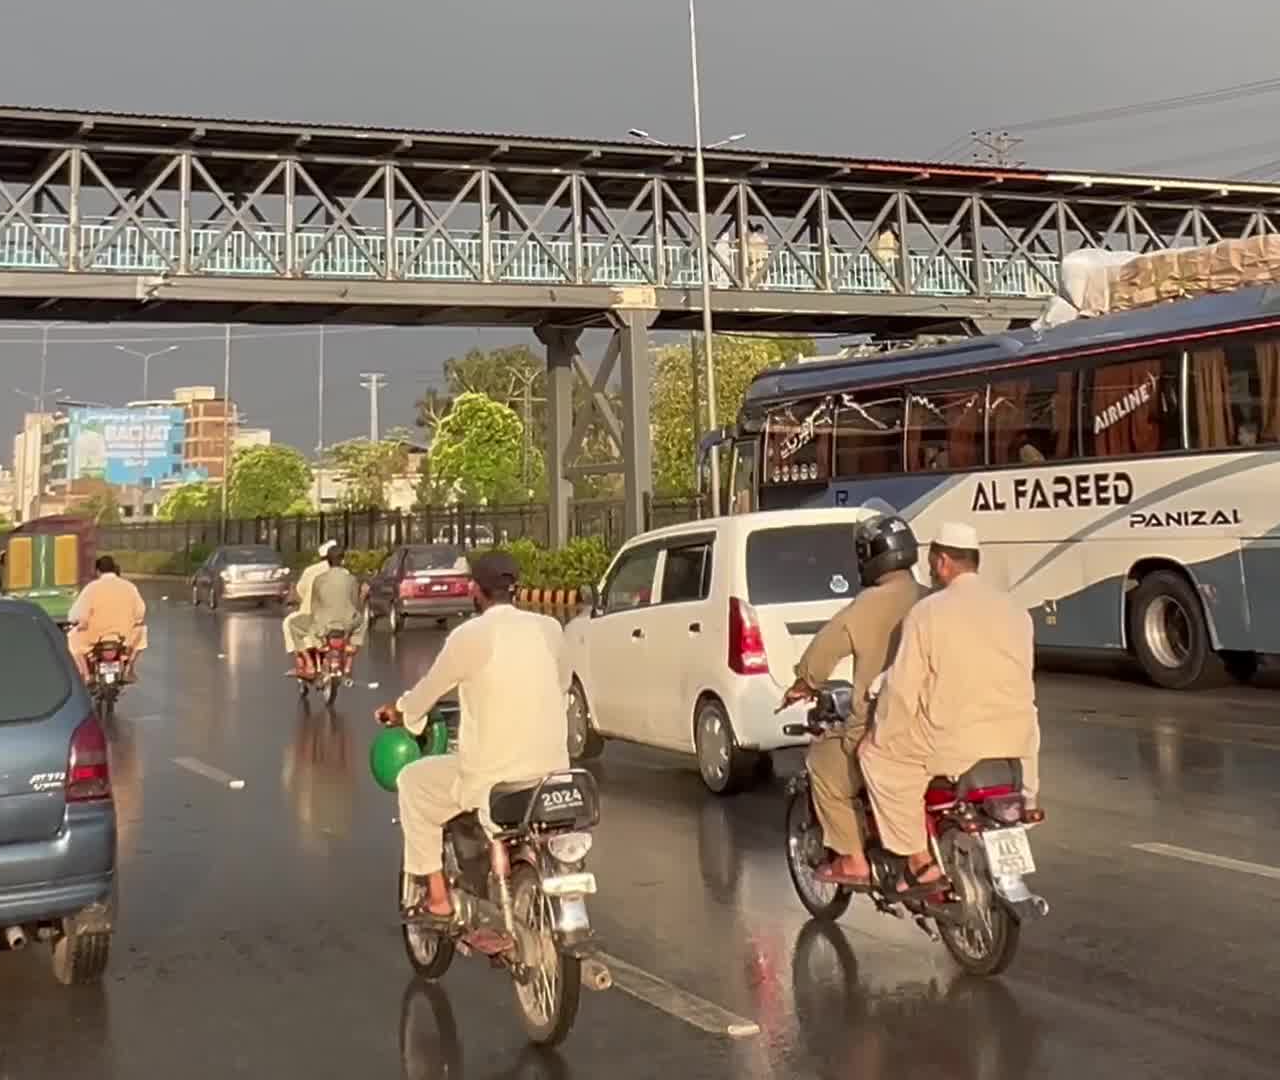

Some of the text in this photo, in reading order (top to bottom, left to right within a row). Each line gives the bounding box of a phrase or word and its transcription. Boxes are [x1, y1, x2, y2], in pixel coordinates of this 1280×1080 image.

[972, 471, 1134, 511] AL FAREED
[541, 788, 582, 806] 2024
